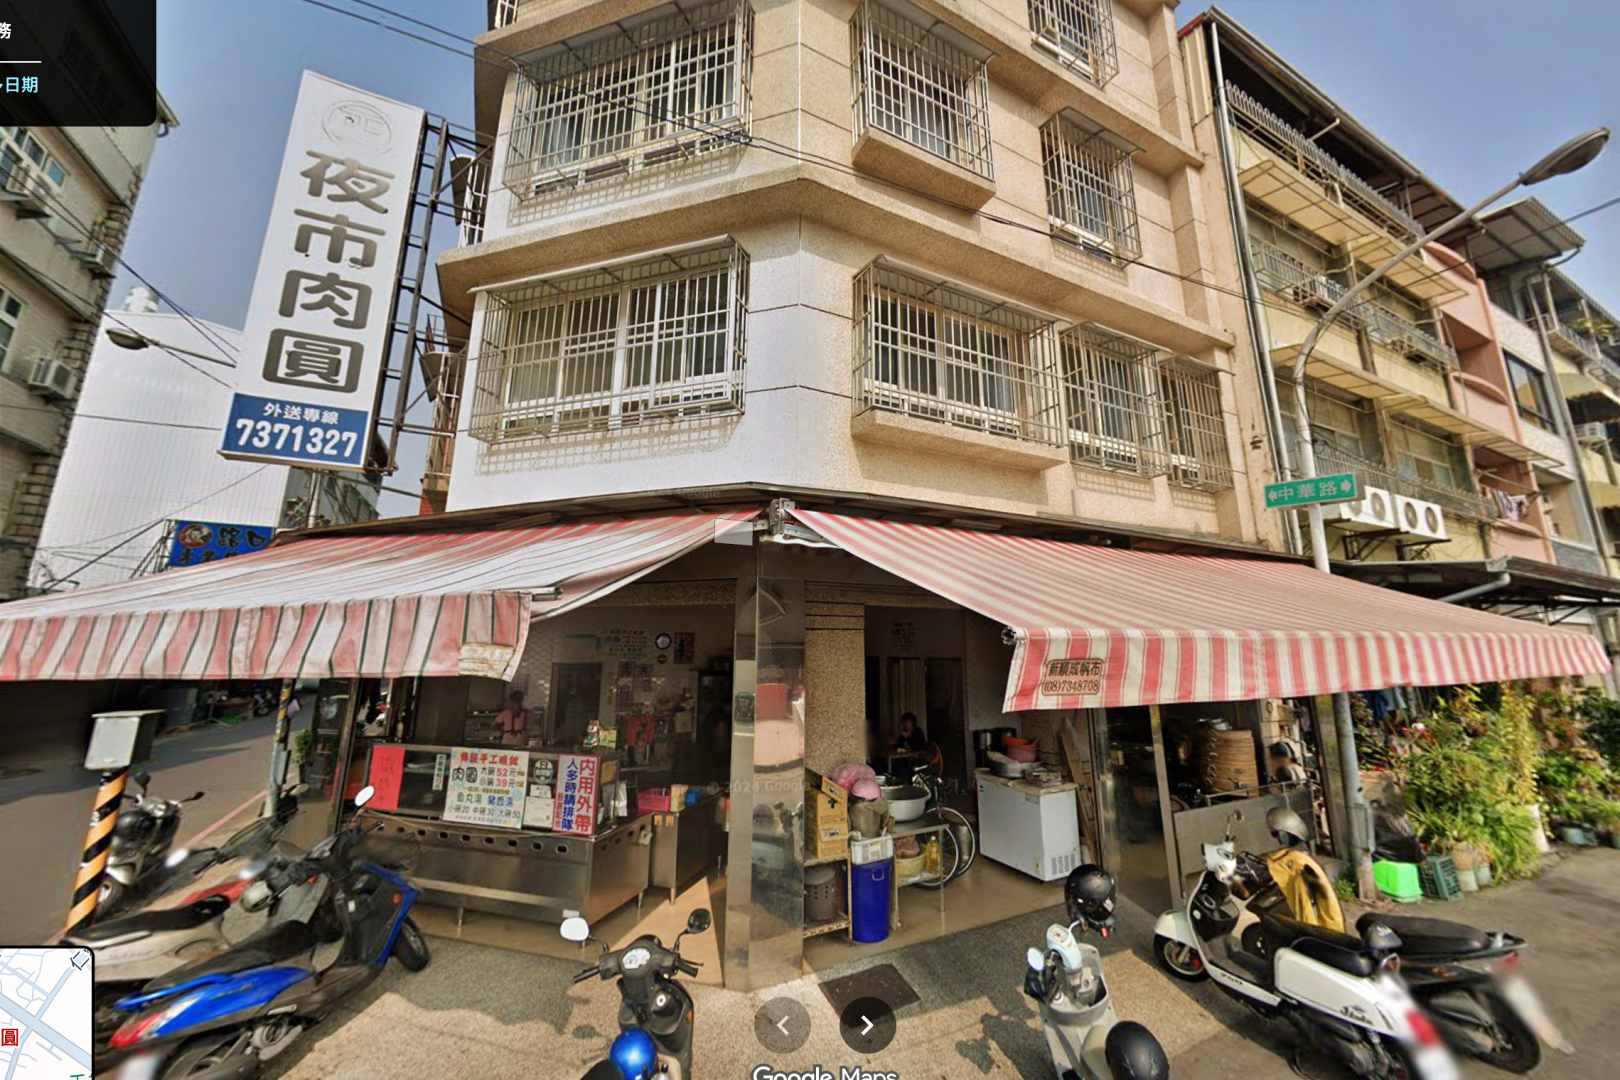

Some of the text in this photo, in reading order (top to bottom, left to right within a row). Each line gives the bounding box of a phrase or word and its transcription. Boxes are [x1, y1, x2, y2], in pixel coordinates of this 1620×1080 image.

[261, 149, 395, 394] 夜市肉圓
[263, 402, 339, 425] 外送專線
[236, 418, 358, 457] 7371327
